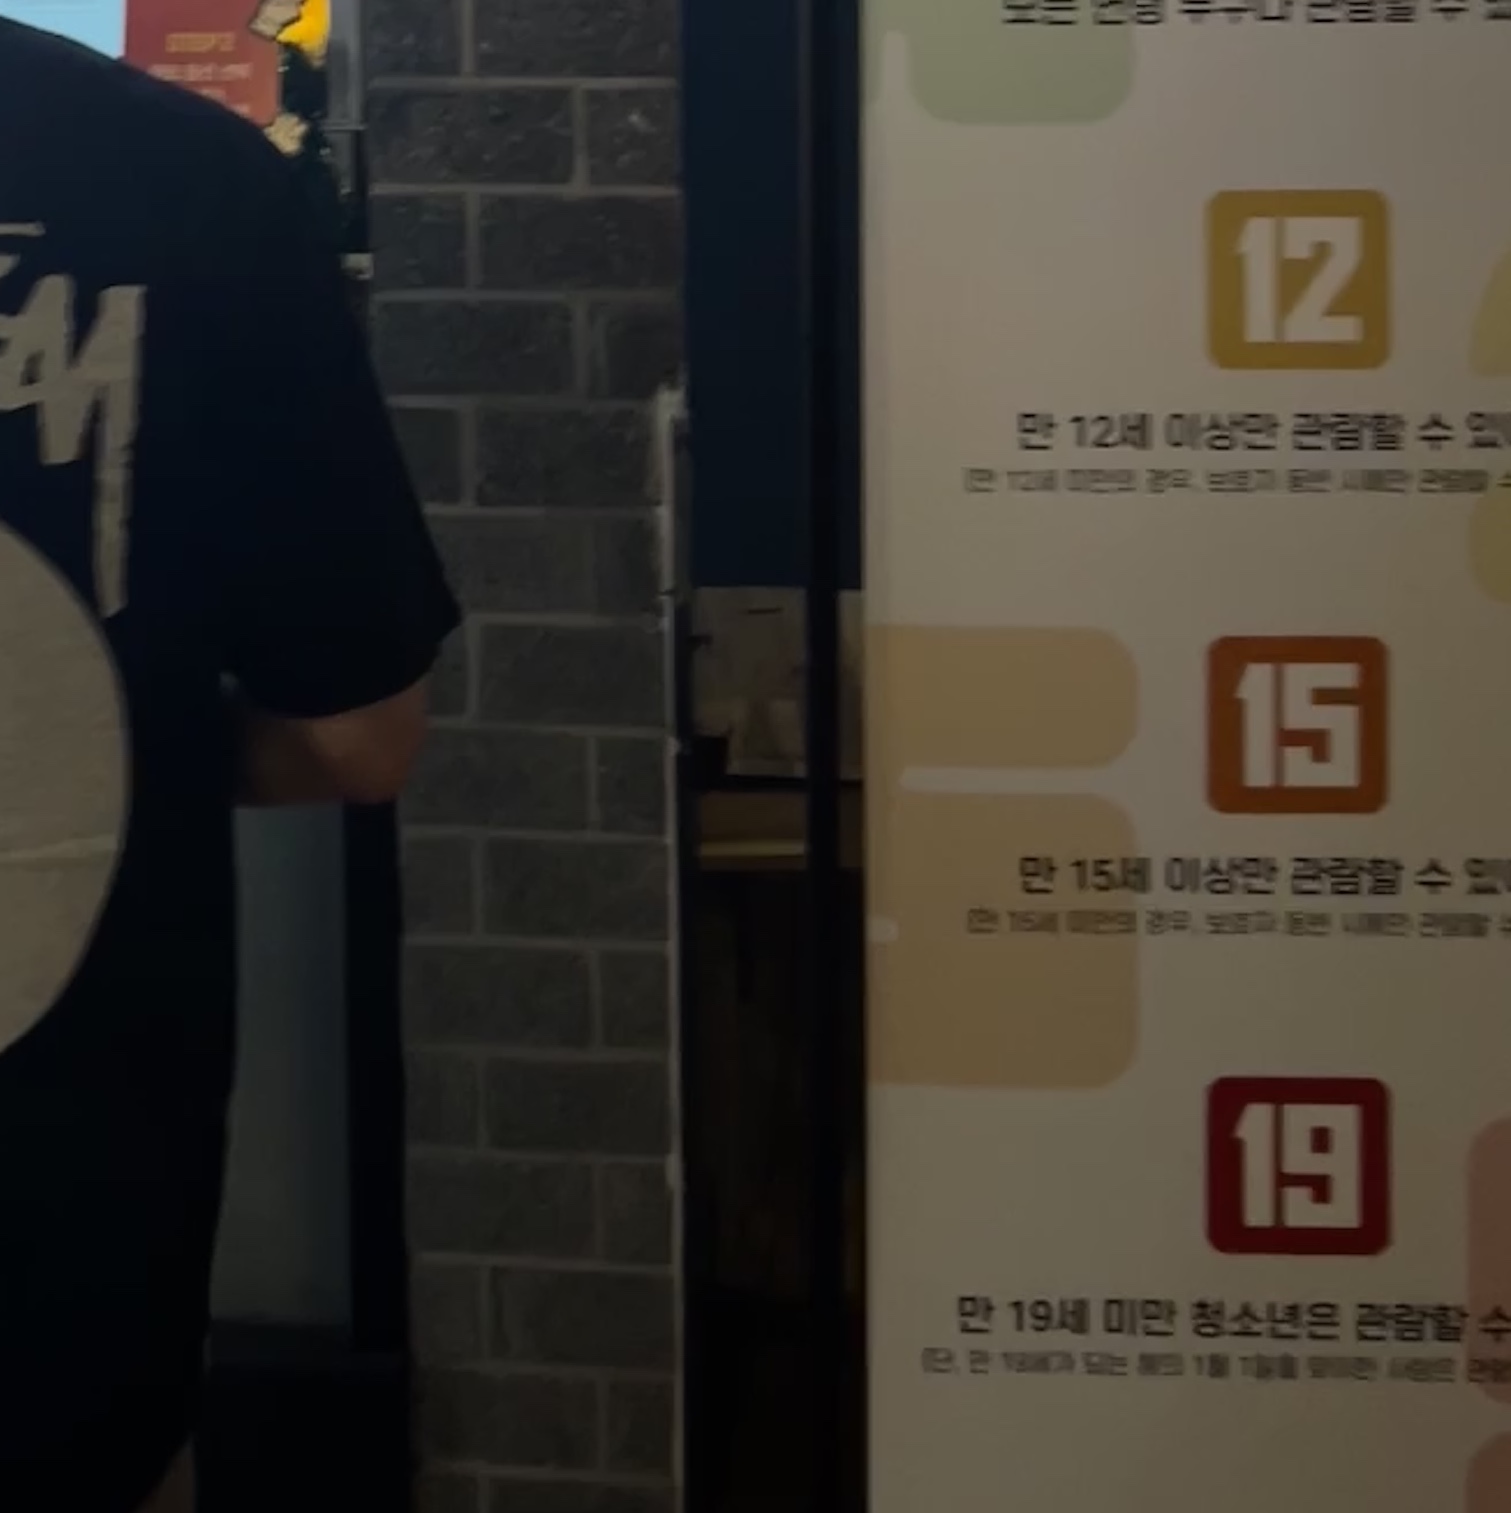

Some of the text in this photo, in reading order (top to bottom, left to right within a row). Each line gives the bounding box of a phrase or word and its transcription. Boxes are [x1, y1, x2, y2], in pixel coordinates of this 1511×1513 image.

[1234, 217, 1363, 344] 12
[1016, 413, 1057, 451] 만
[1071, 413, 1152, 450] 12세
[1164, 413, 1281, 450] 이상만
[1292, 412, 1408, 450] 관람할
[1416, 413, 1455, 450] 수
[1234, 662, 1361, 787] 15
[1020, 857, 1057, 895] 만
[1071, 858, 1151, 894] 15세
[1164, 858, 1280, 894] 이상만
[1290, 858, 1404, 895] 관람할
[1414, 858, 1453, 894] 수
[1234, 1102, 1363, 1228] 19
[957, 1296, 993, 1335] 만
[1009, 1298, 1089, 1336] 19세
[1103, 1298, 1176, 1337] 미만
[1191, 1300, 1340, 1340] 청소년은
[1355, 1302, 1467, 1342] 관람할
